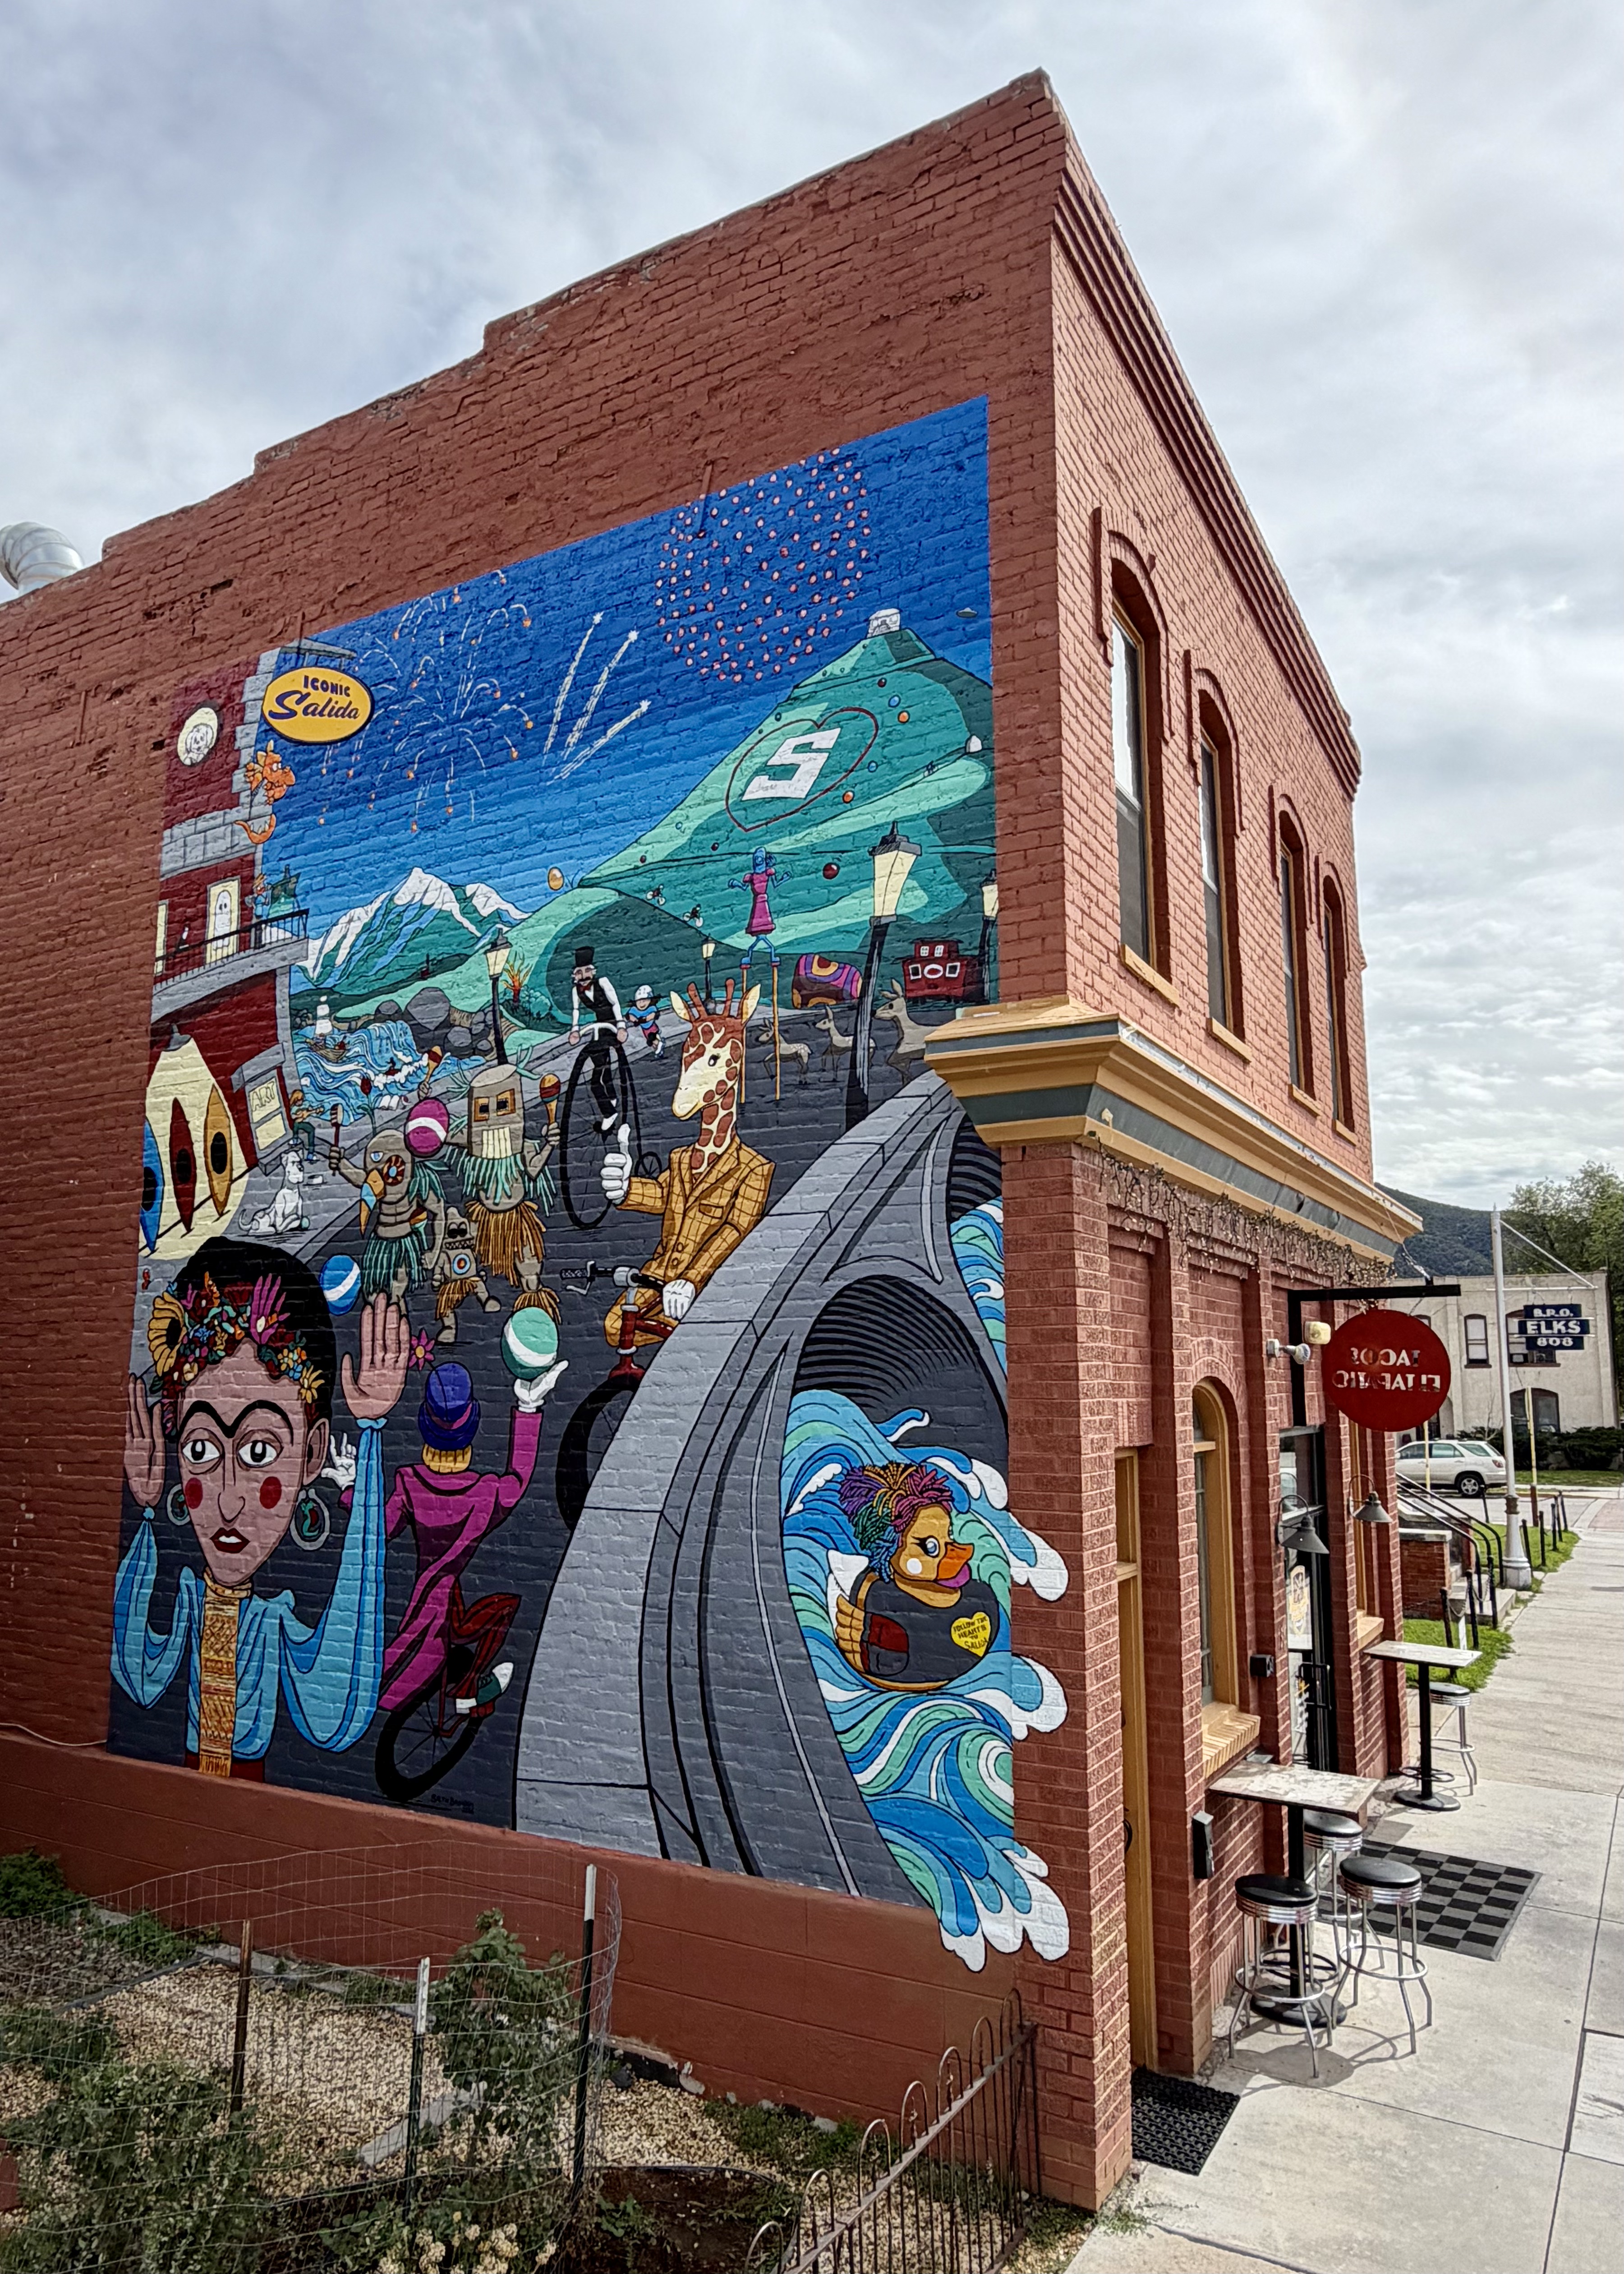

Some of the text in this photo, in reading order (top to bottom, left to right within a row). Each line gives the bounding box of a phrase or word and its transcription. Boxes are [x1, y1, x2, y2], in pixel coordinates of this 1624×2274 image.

[304, 675, 350, 697] ICONIC
[268, 690, 359, 720] Salida
[742, 728, 841, 800] S
[251, 1080, 275, 1112] ART
[1526, 1320, 1581, 1334] ELKS
[1537, 1337, 1573, 1347] 808
